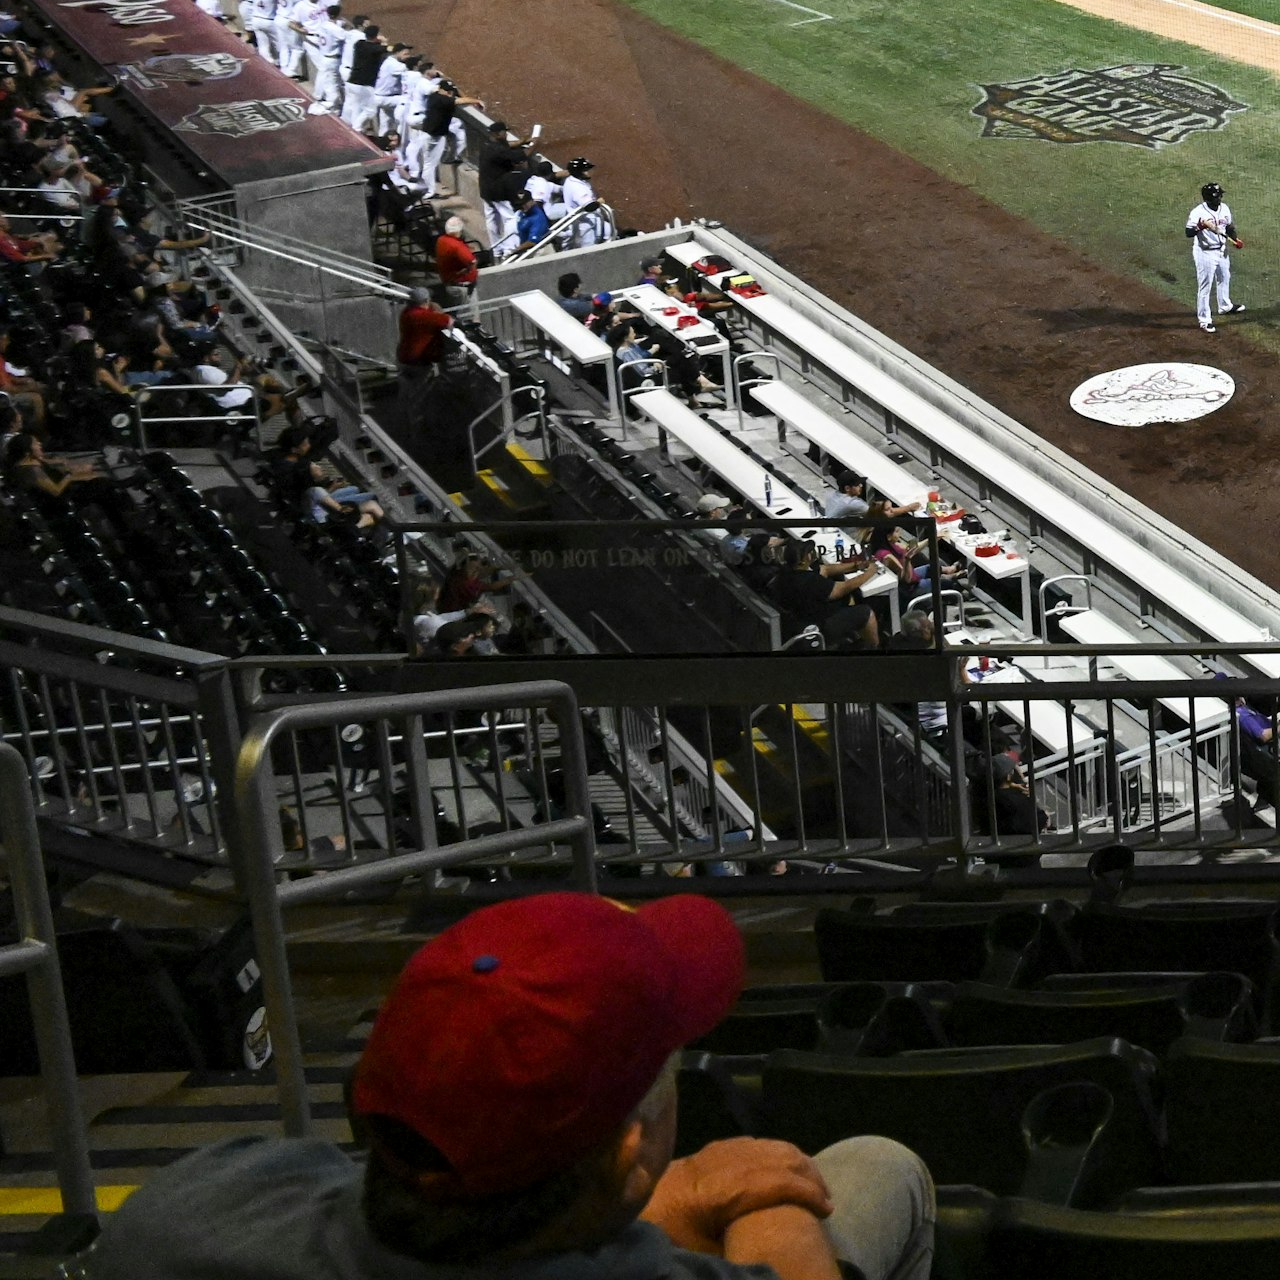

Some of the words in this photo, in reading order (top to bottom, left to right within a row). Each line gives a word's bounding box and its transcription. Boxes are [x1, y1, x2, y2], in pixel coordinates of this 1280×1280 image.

[531, 549, 554, 568] DO
[563, 548, 599, 568] NOT
[608, 547, 656, 567] LEAN
[663, 547, 690, 566] ON
